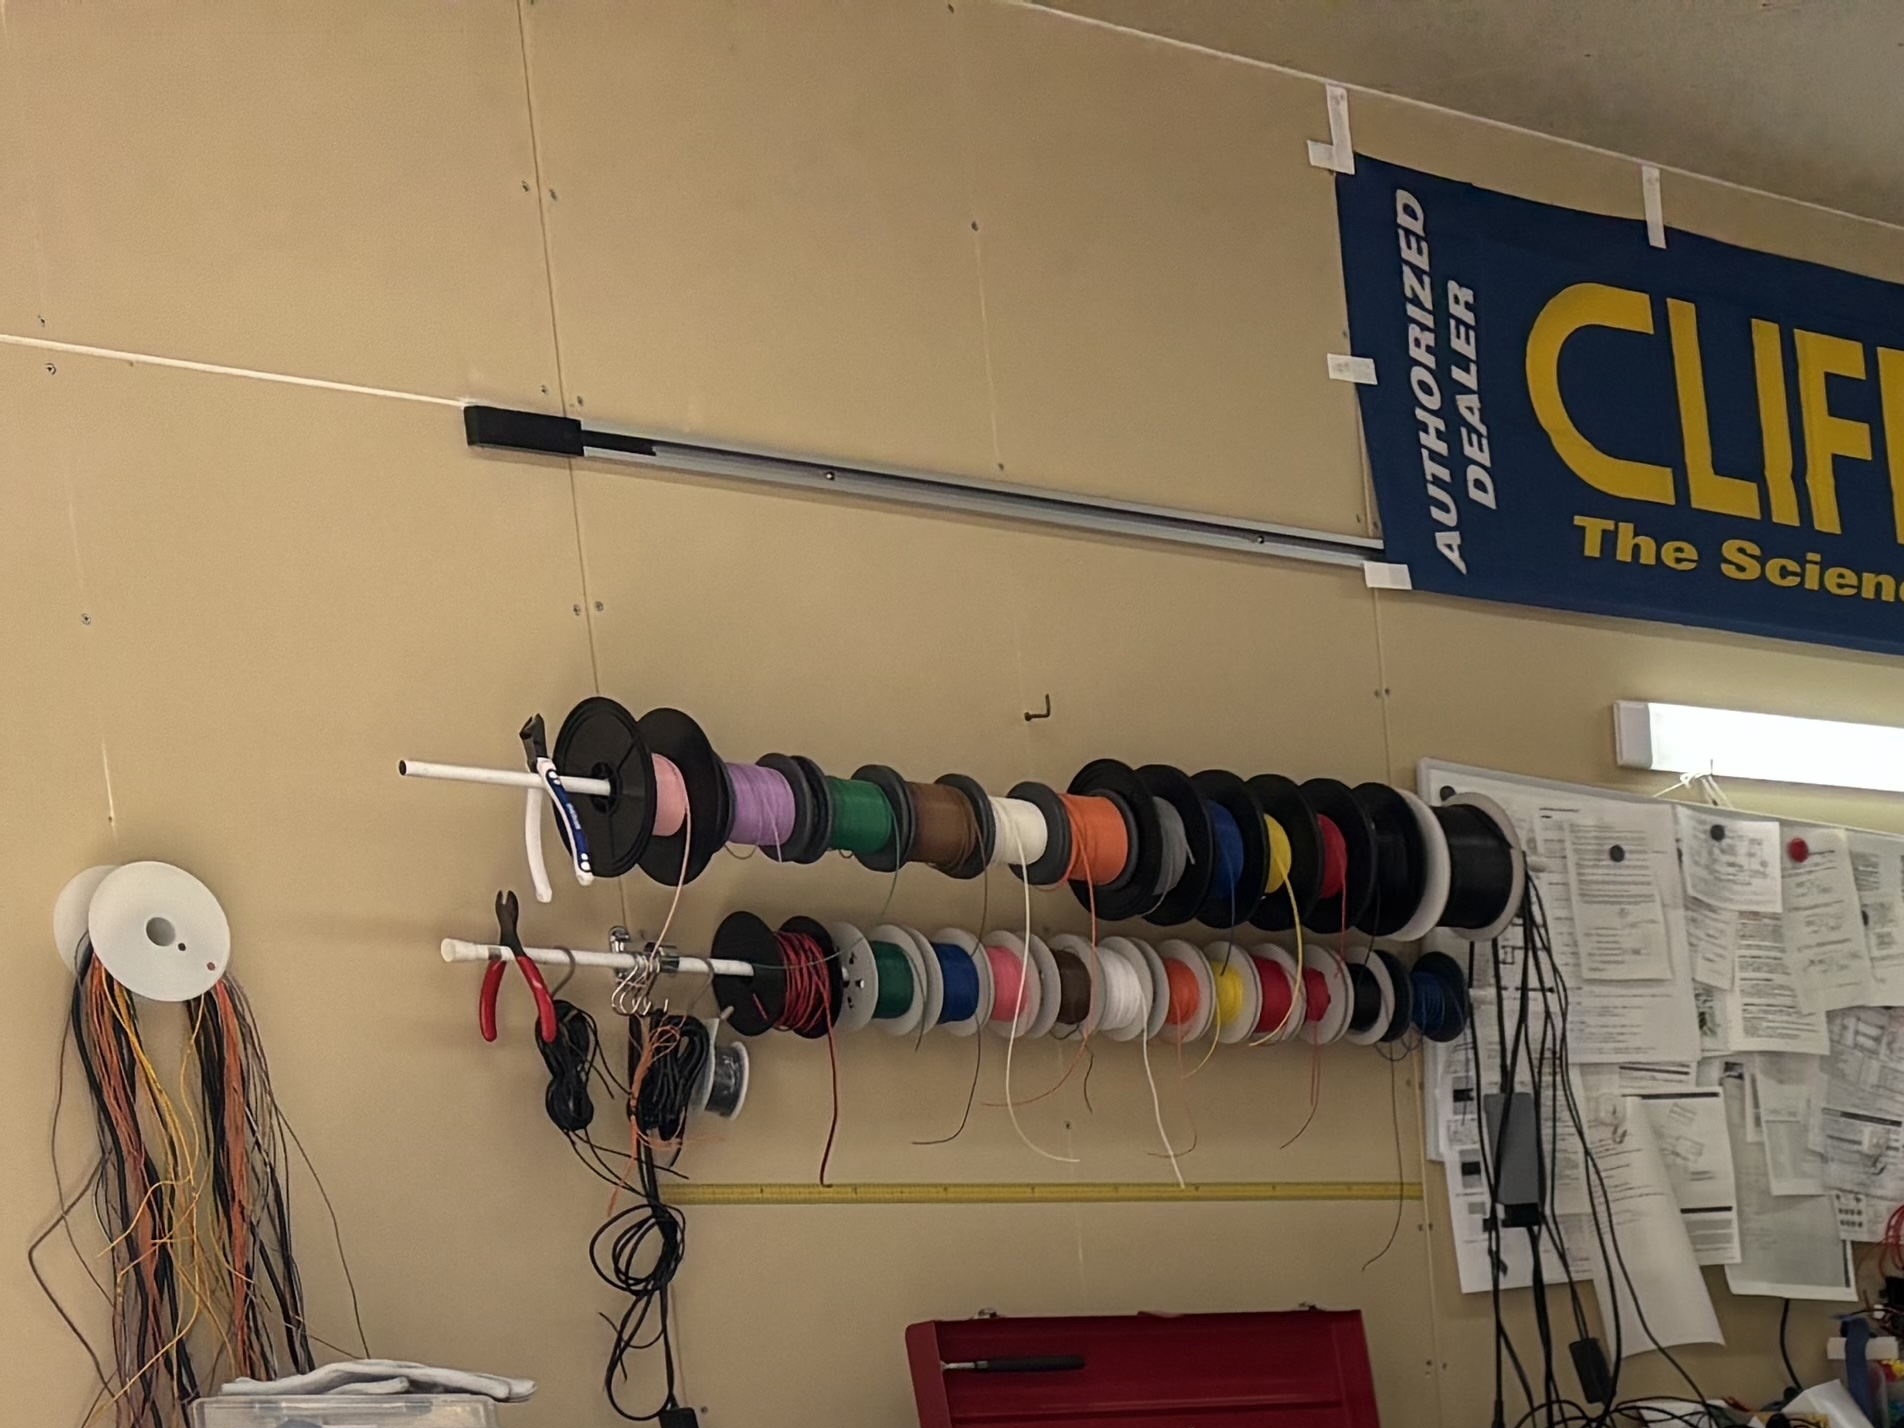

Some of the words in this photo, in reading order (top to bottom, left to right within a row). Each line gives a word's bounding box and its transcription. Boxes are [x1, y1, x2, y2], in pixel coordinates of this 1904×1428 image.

[1395, 188, 1468, 576] AUTHORIZED
[1446, 278, 1498, 511] DEALER
[1572, 514, 1700, 572] The
